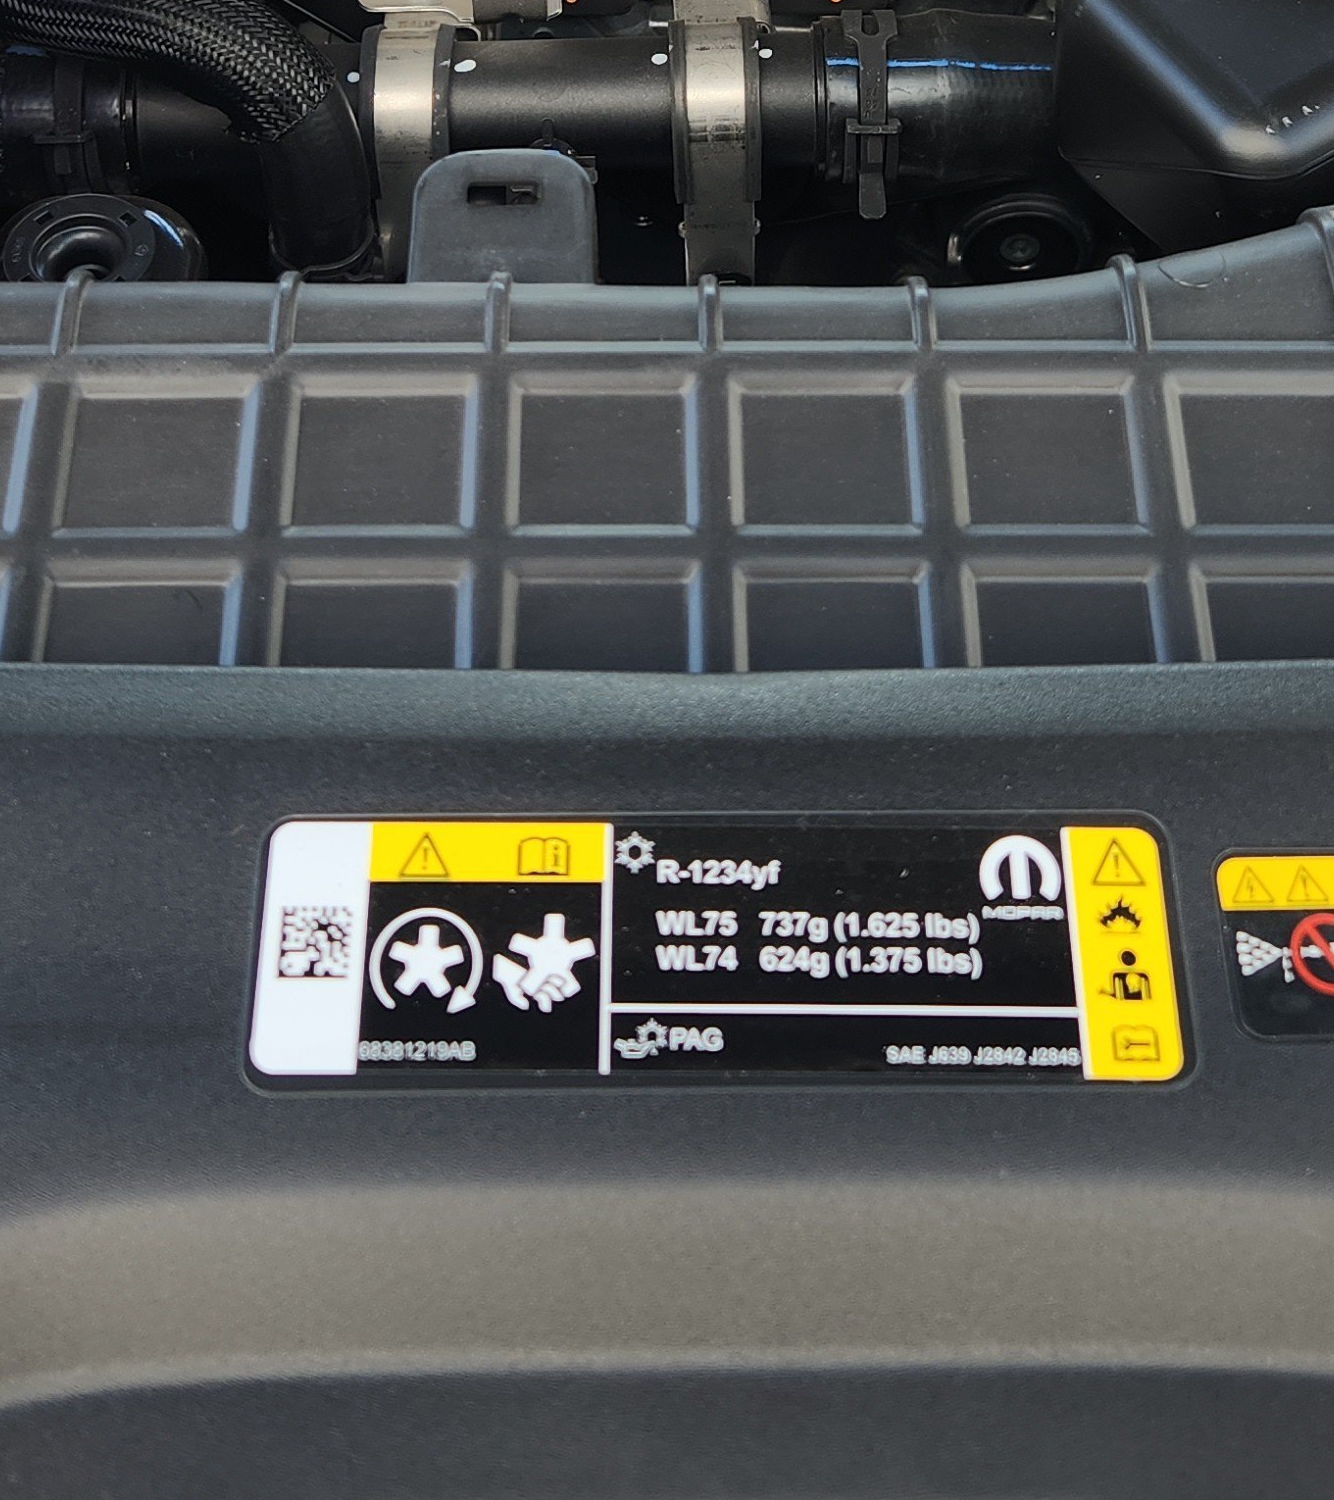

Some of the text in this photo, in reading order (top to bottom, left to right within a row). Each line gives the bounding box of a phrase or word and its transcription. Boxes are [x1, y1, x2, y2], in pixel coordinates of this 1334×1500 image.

[656, 859, 782, 891] R-1234yf
[981, 905, 1065, 920] MOPAR
[655, 910, 981, 945] WL75 737g (1.625 lbs)
[655, 944, 983, 980] WL74 624g (1.375 lbs)
[669, 1026, 724, 1052] PAG
[885, 1044, 1080, 1067] SAE J639 J2842 J2845
